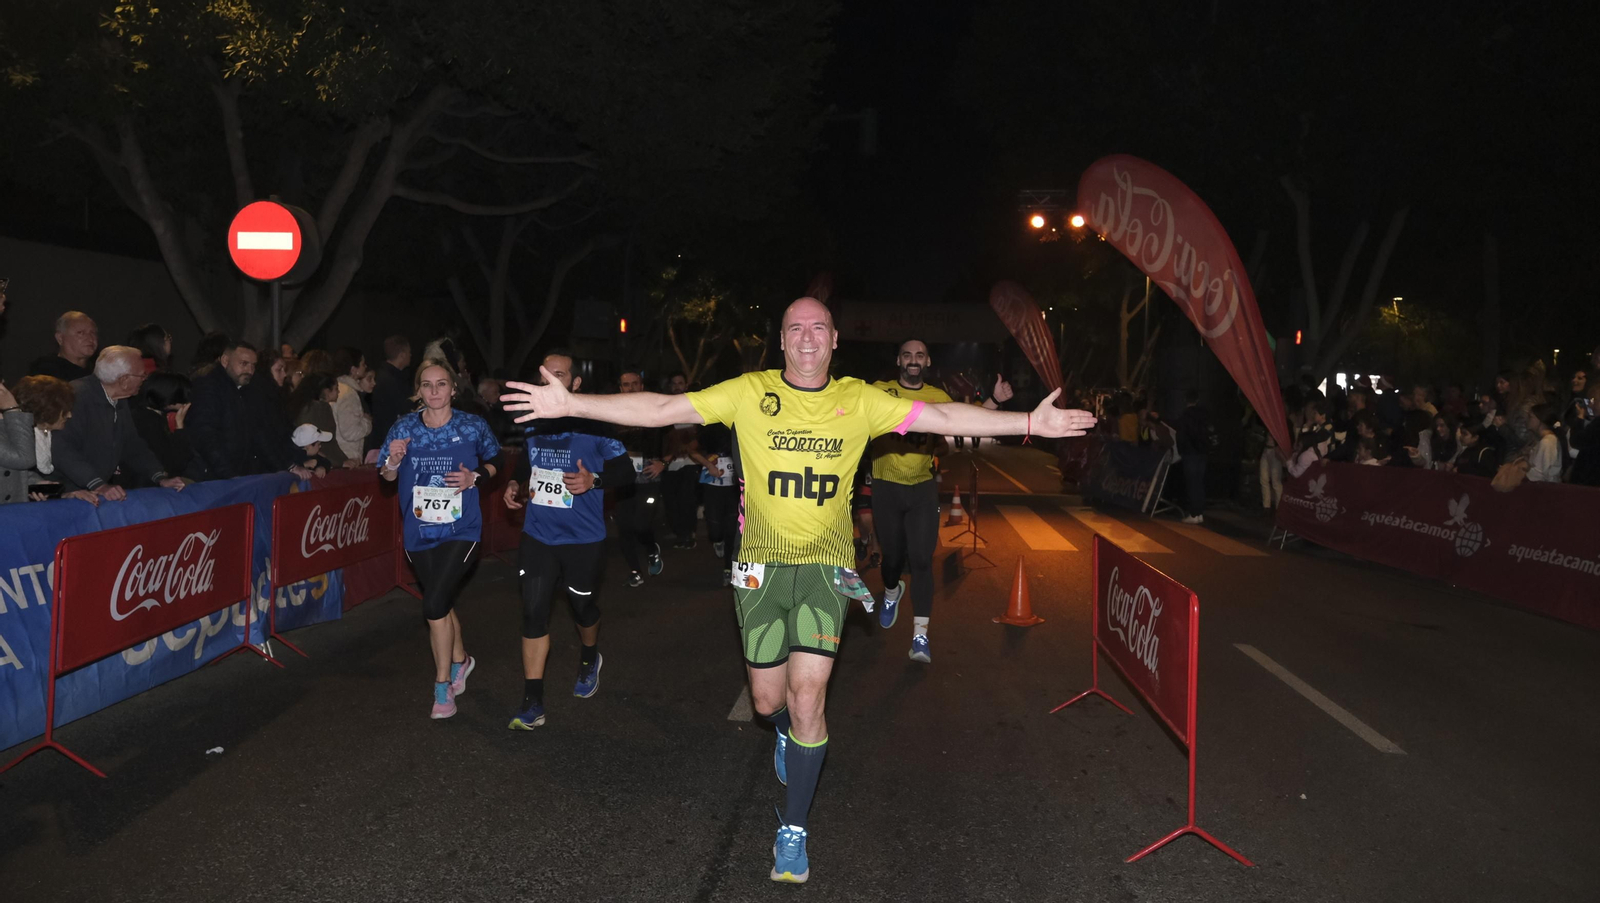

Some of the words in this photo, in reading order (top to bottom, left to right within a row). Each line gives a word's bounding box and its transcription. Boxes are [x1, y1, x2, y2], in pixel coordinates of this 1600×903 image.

[770, 435, 844, 452] SPORTGYM
[537, 481, 562, 494] 768
[768, 466, 840, 506] mtp
[423, 499, 451, 510] 767
[301, 495, 373, 558] Coca-Cola
[1360, 511, 1457, 541] aquéatacamos
[110, 528, 222, 621] Coca-Cola
[1107, 566, 1164, 673] Coca-Cola
